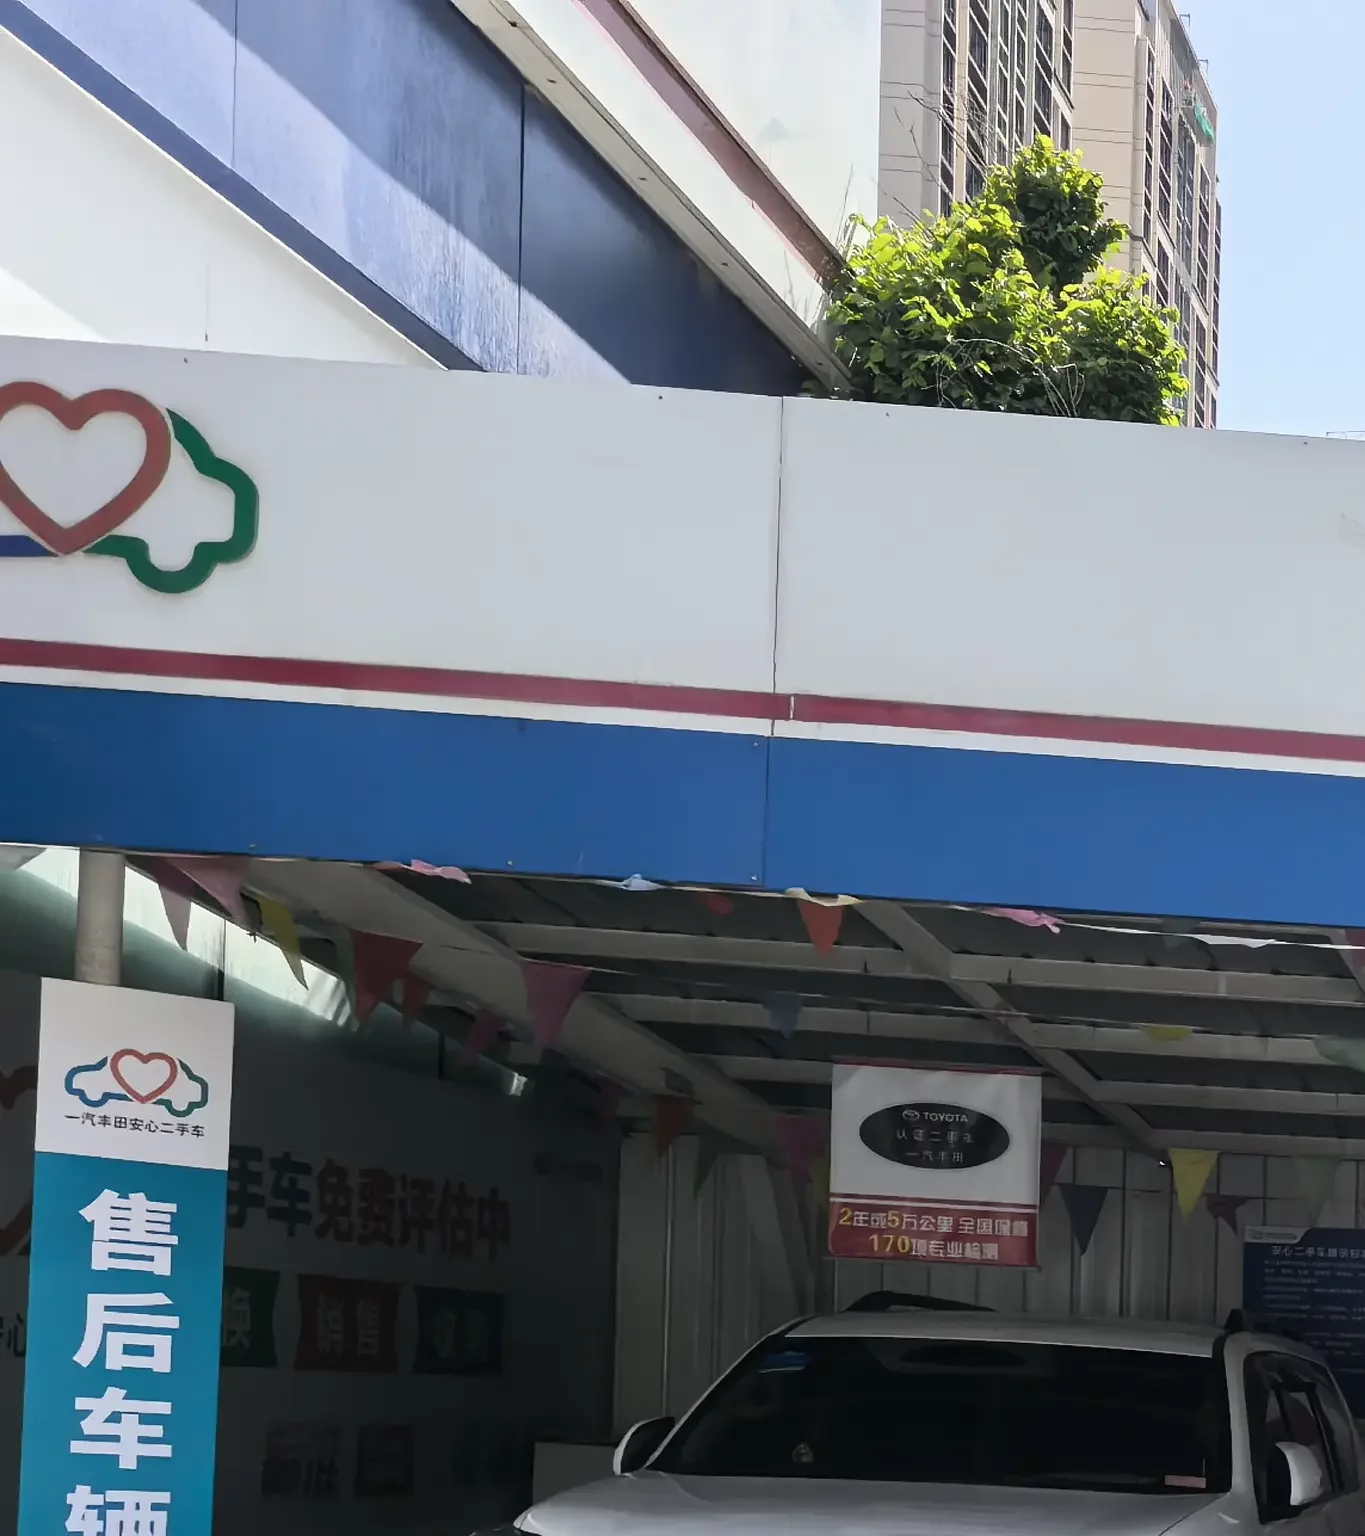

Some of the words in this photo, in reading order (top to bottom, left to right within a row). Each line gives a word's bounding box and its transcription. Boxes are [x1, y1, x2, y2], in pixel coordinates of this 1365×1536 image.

[64, 1111, 206, 1139] 一汽丰田安心二手车
[922, 1111, 969, 1124] TOYOTA
